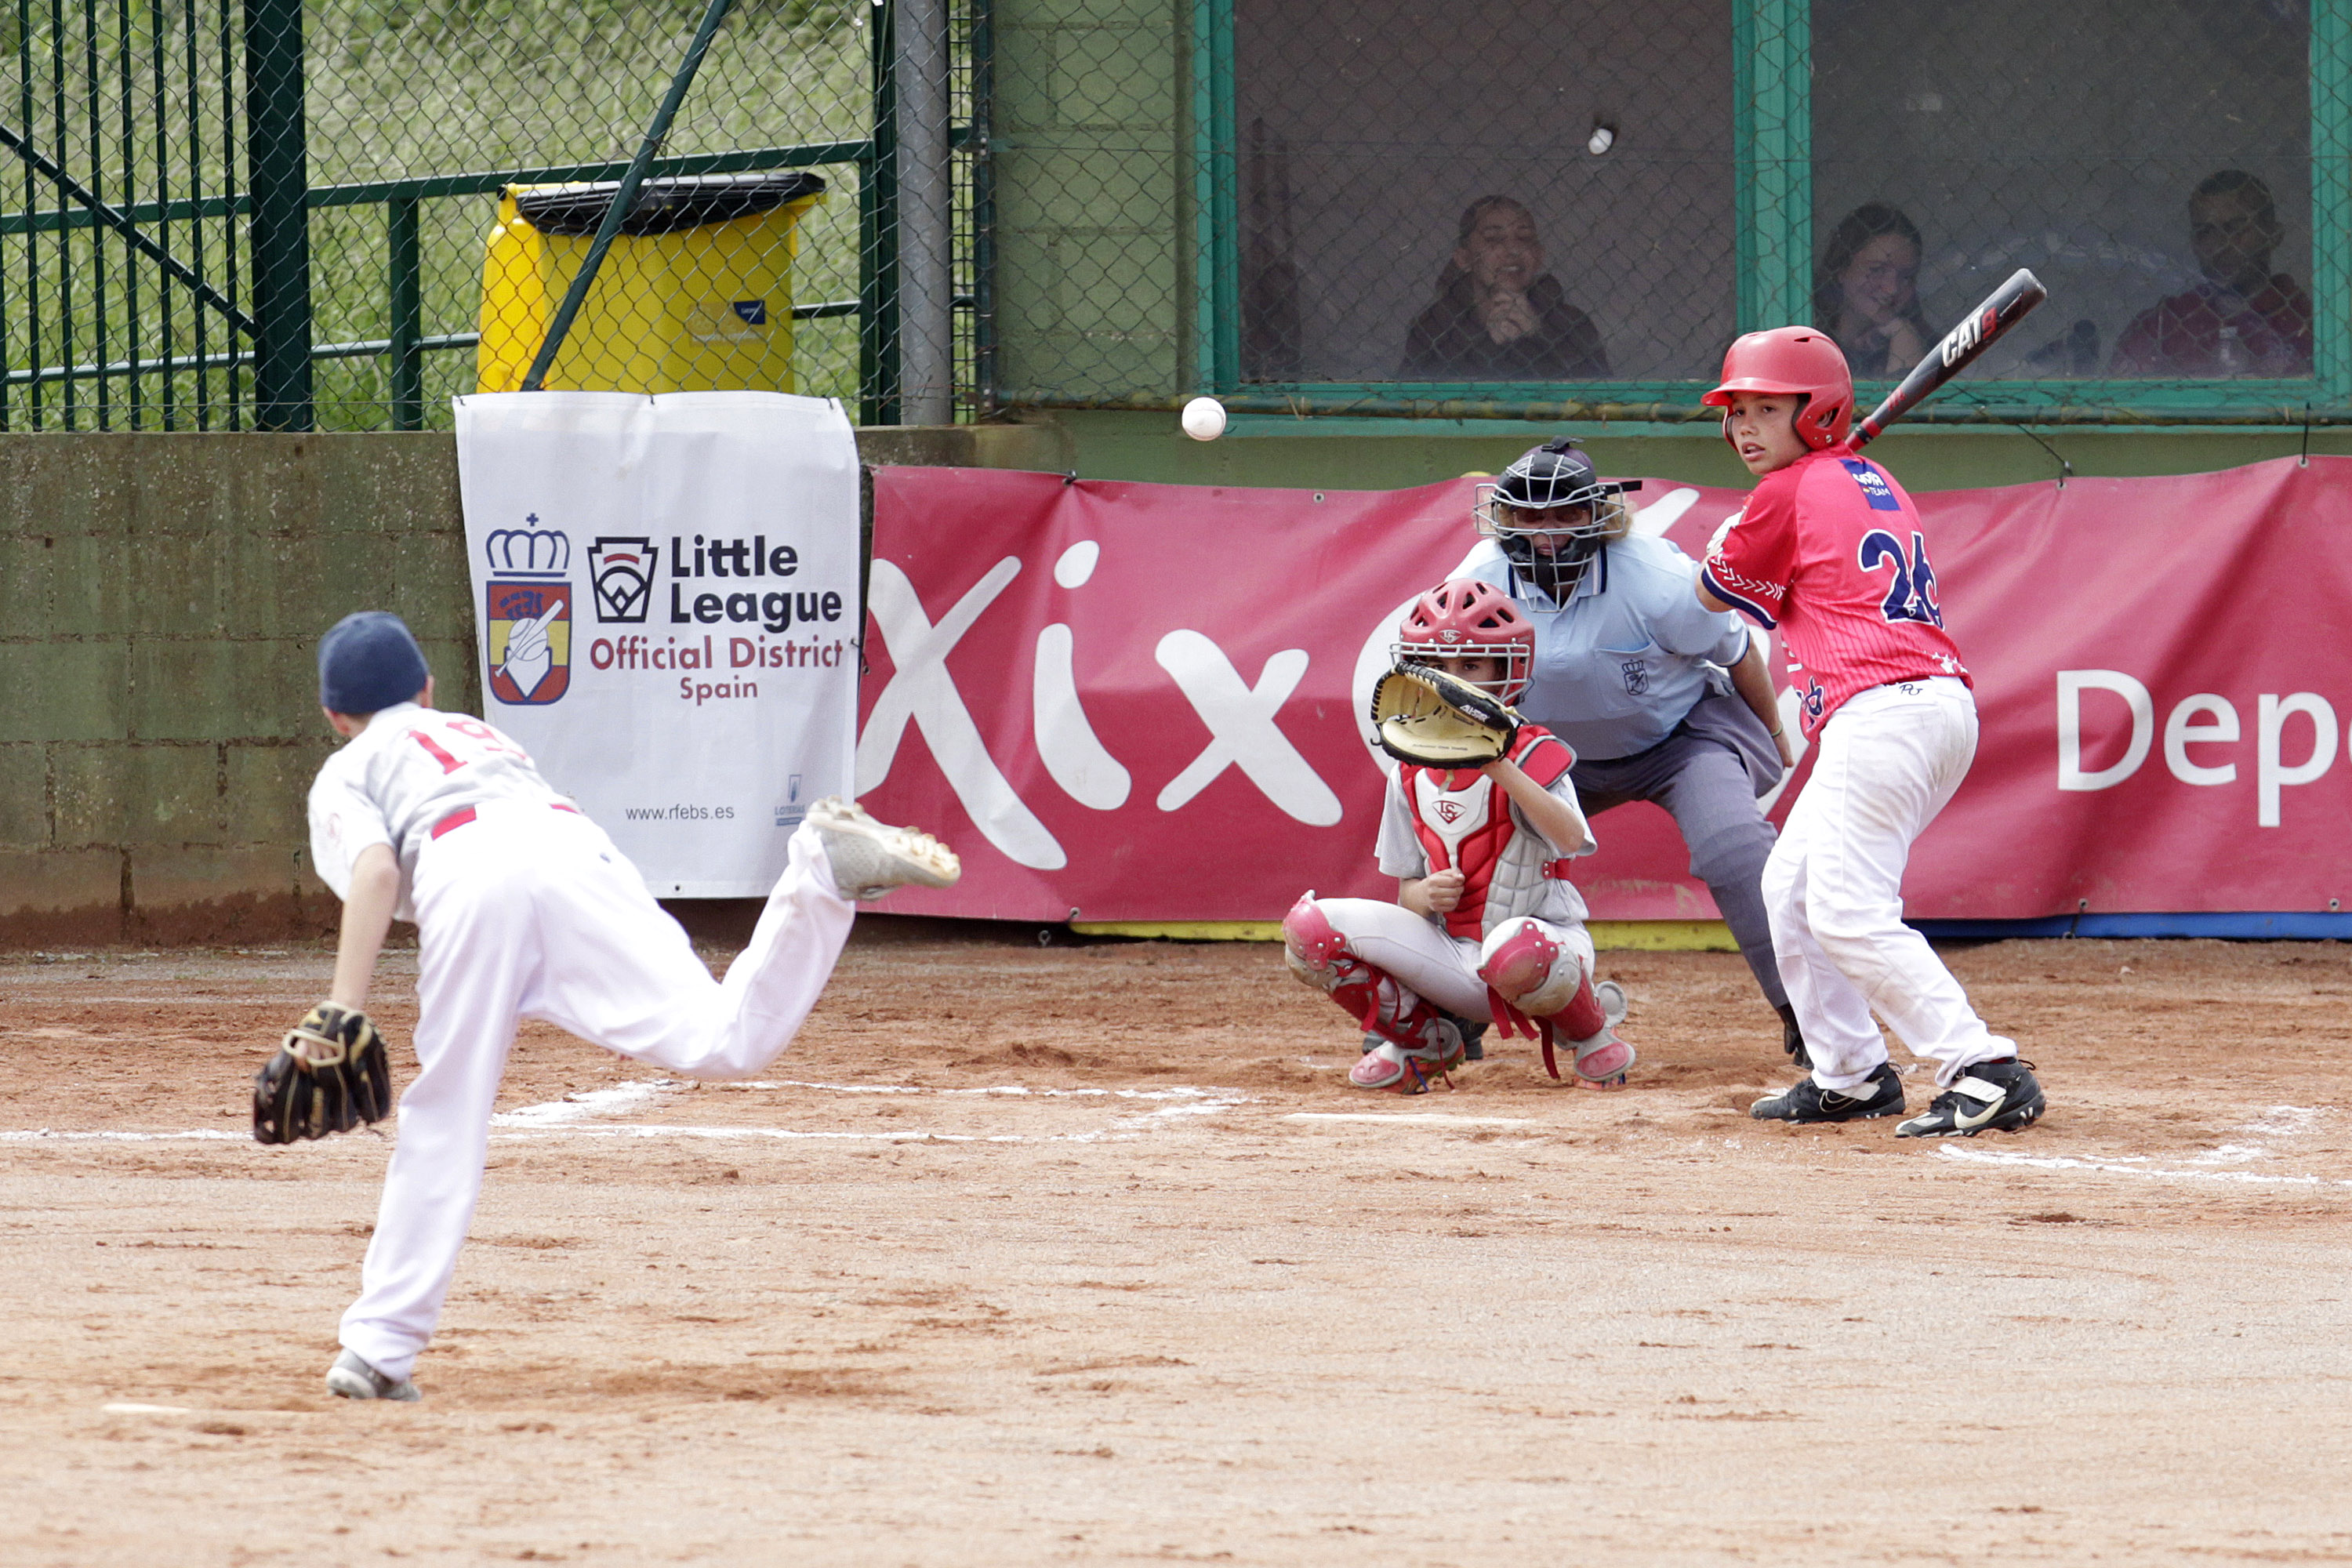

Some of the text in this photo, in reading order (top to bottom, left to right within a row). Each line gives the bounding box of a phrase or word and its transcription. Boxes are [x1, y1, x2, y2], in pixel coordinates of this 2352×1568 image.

[671, 534, 798, 578] Little
[670, 582, 842, 634] League
[590, 633, 844, 670] Official District
[680, 674, 758, 706] Spain
[2056, 669, 2352, 827] Dep
[626, 803, 735, 820] www.rfebs.es
